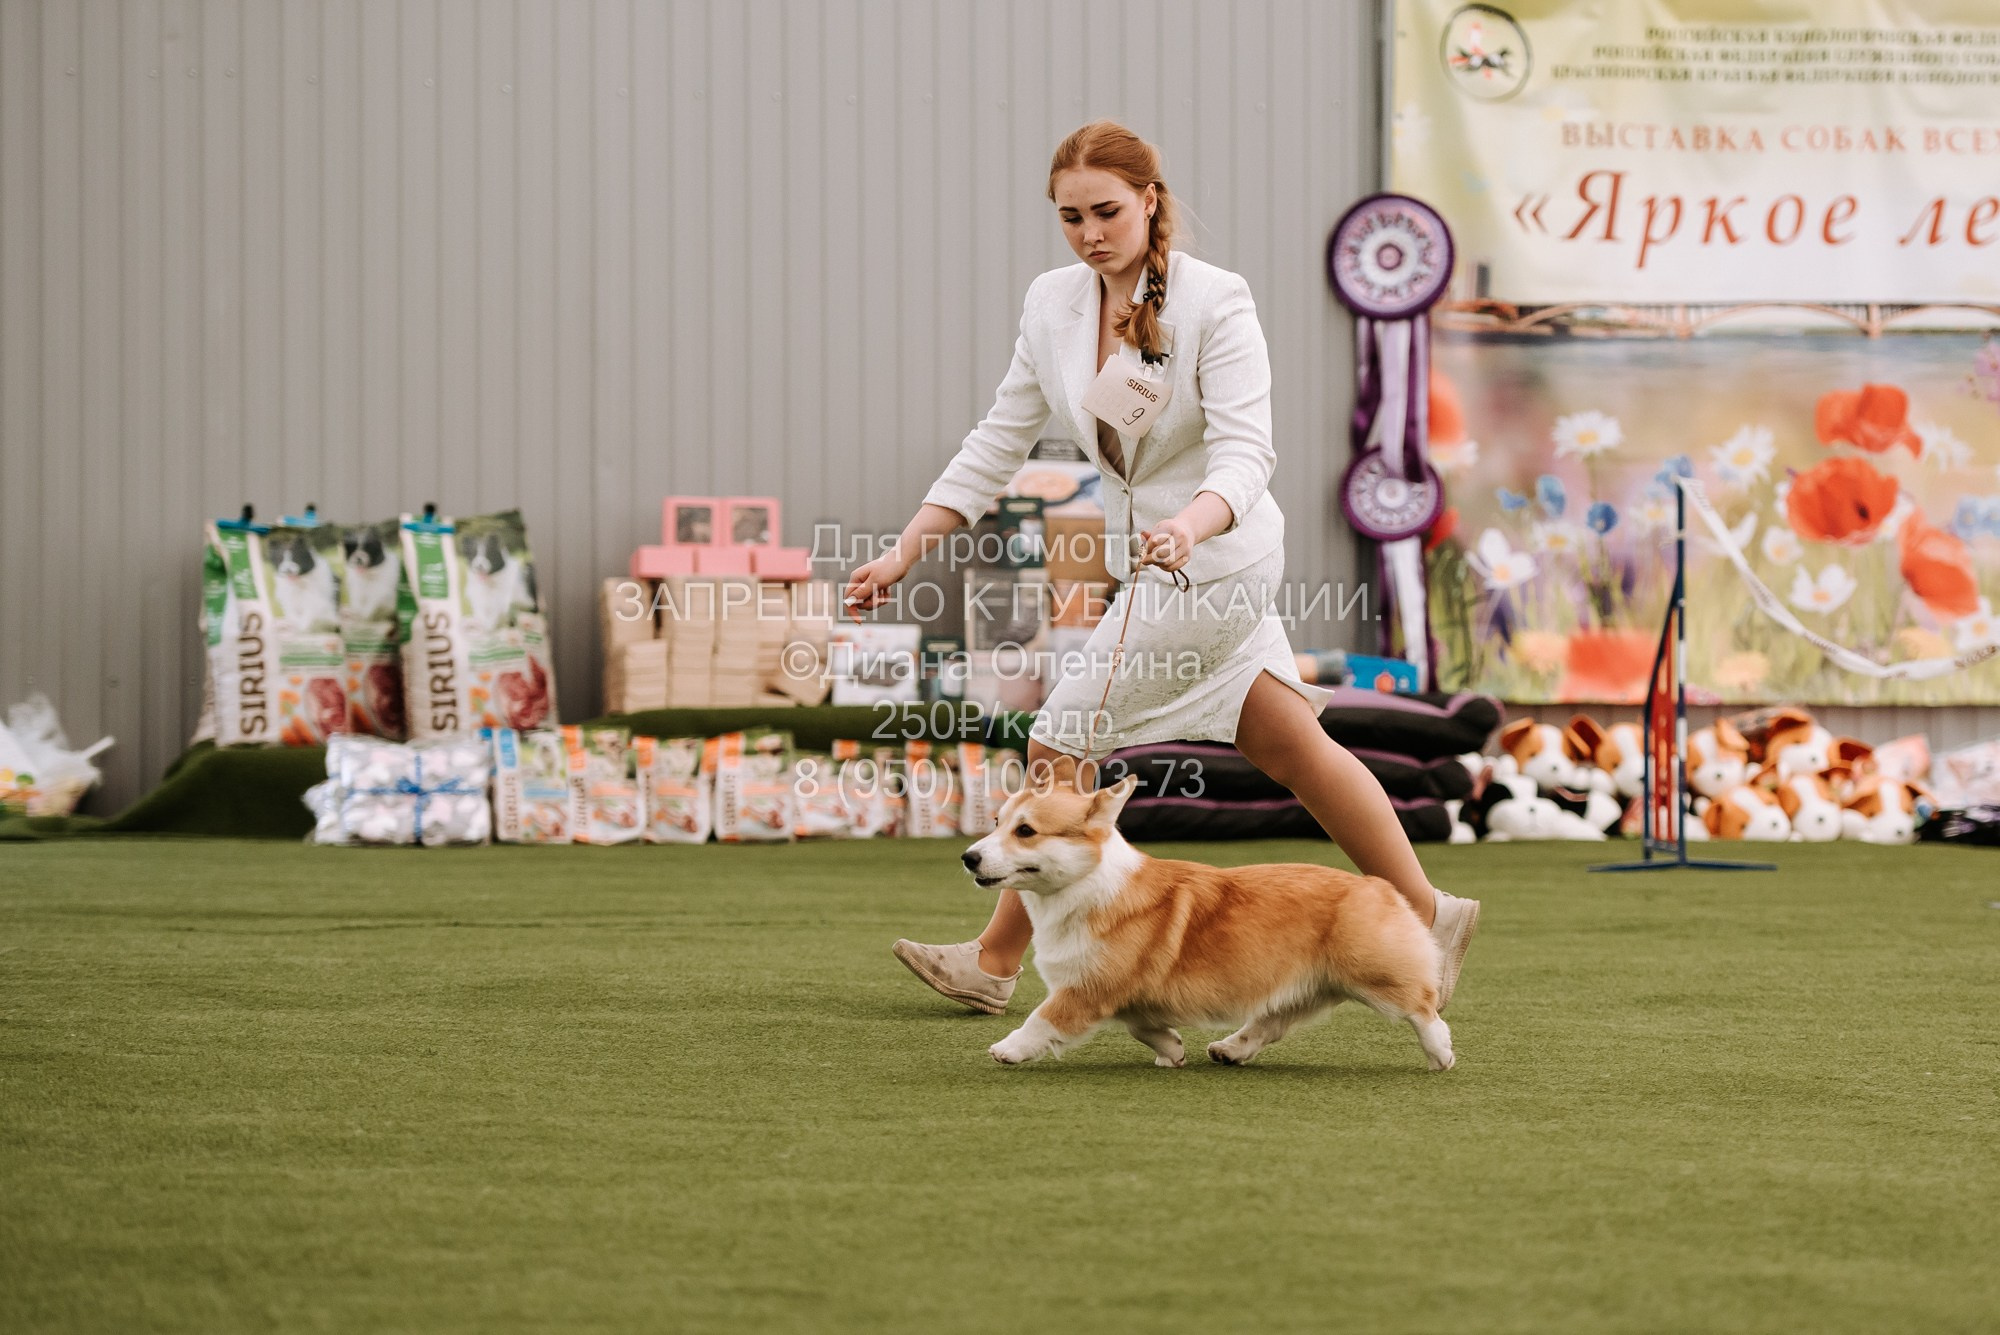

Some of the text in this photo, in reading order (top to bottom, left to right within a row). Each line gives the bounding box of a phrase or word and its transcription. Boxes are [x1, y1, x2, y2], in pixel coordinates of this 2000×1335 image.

[1561, 121, 2000, 155] ВЫСТАВКА СОБАК ВСЕ
[1512, 168, 1858, 271] «Яркое
[1897, 195, 2000, 247] ле
[1122, 407, 1146, 426] 9
[1126, 378, 1158, 403] SIRIUS
[240, 612, 268, 736] SIRIUS
[425, 610, 459, 733] SIRIUS
